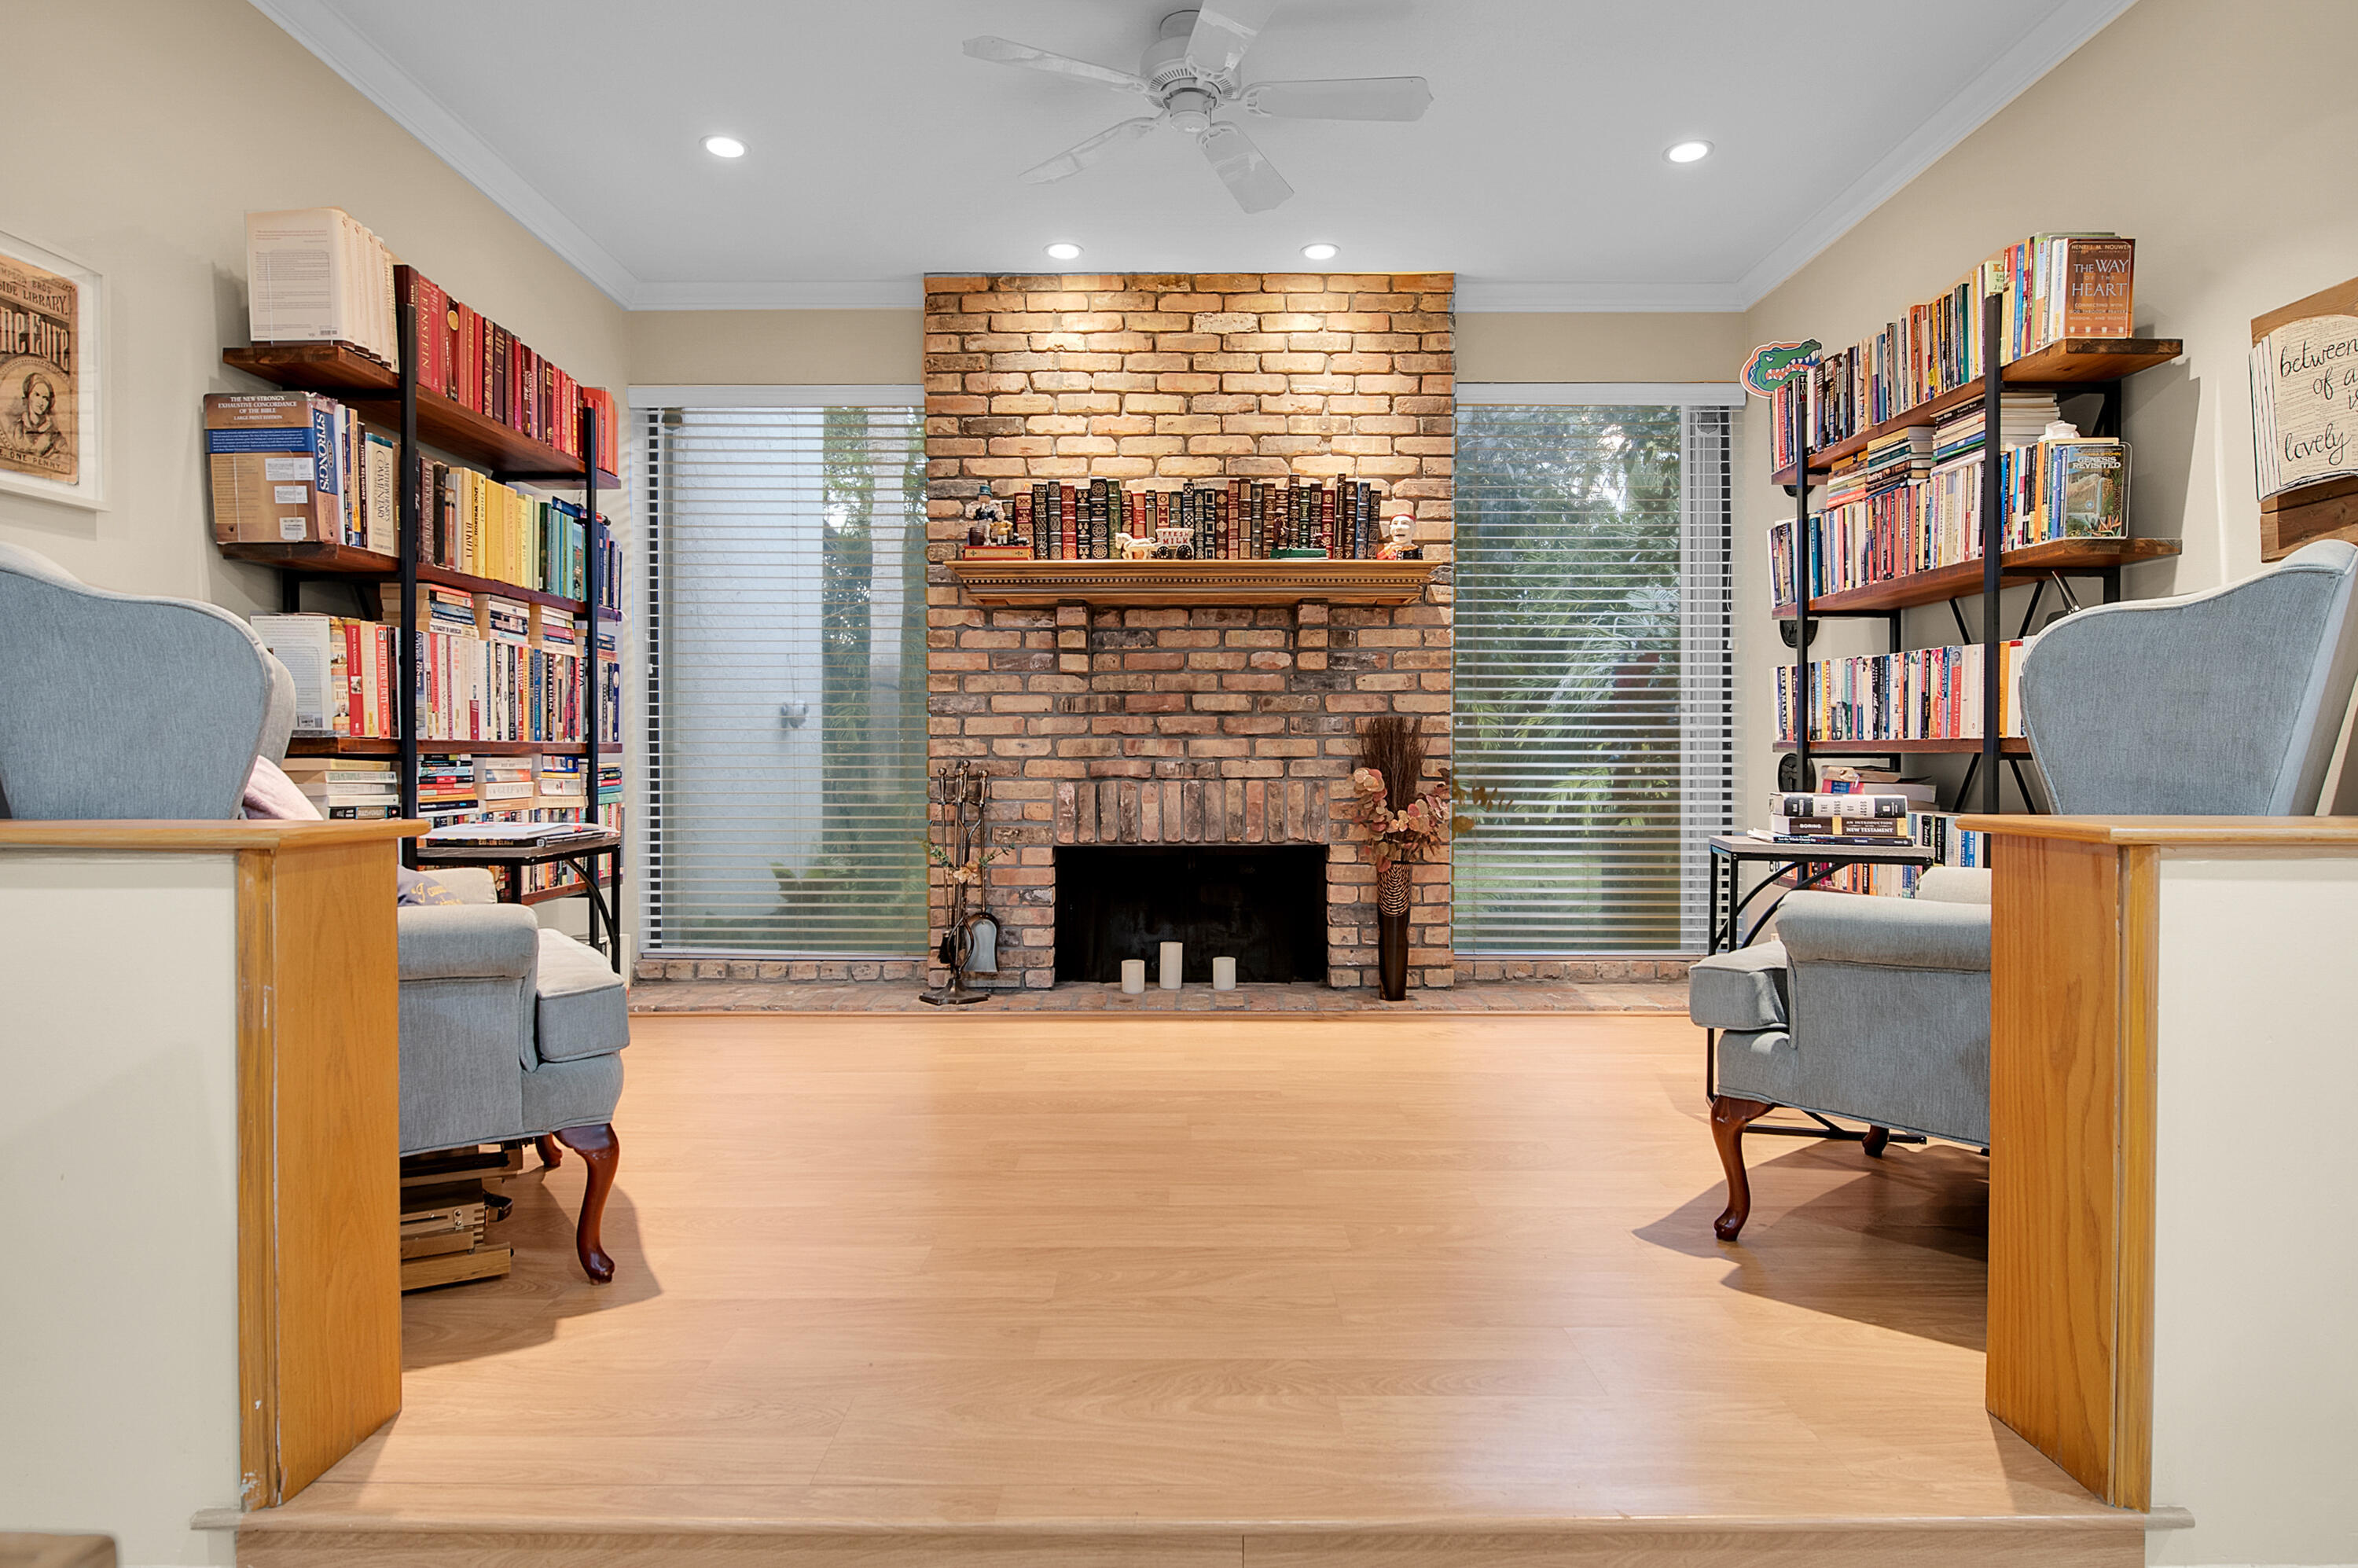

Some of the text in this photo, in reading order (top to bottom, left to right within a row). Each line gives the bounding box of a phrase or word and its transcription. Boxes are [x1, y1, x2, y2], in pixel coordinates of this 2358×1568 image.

[2073, 259, 2129, 273] THE WAY
[22, 289, 68, 315] LIBRARY.
[2072, 283, 2128, 296] HEART
[28, 310, 70, 373] Eyre
[421, 296, 429, 369] EINSTEIN
[2313, 365, 2333, 400] of
[9, 451, 28, 462] ONE
[315, 412, 329, 491] STRONG'S
[2284, 422, 2352, 467] lovely
[376, 450, 385, 520] COMMENTARY
[379, 641, 387, 681] DERELICTION
